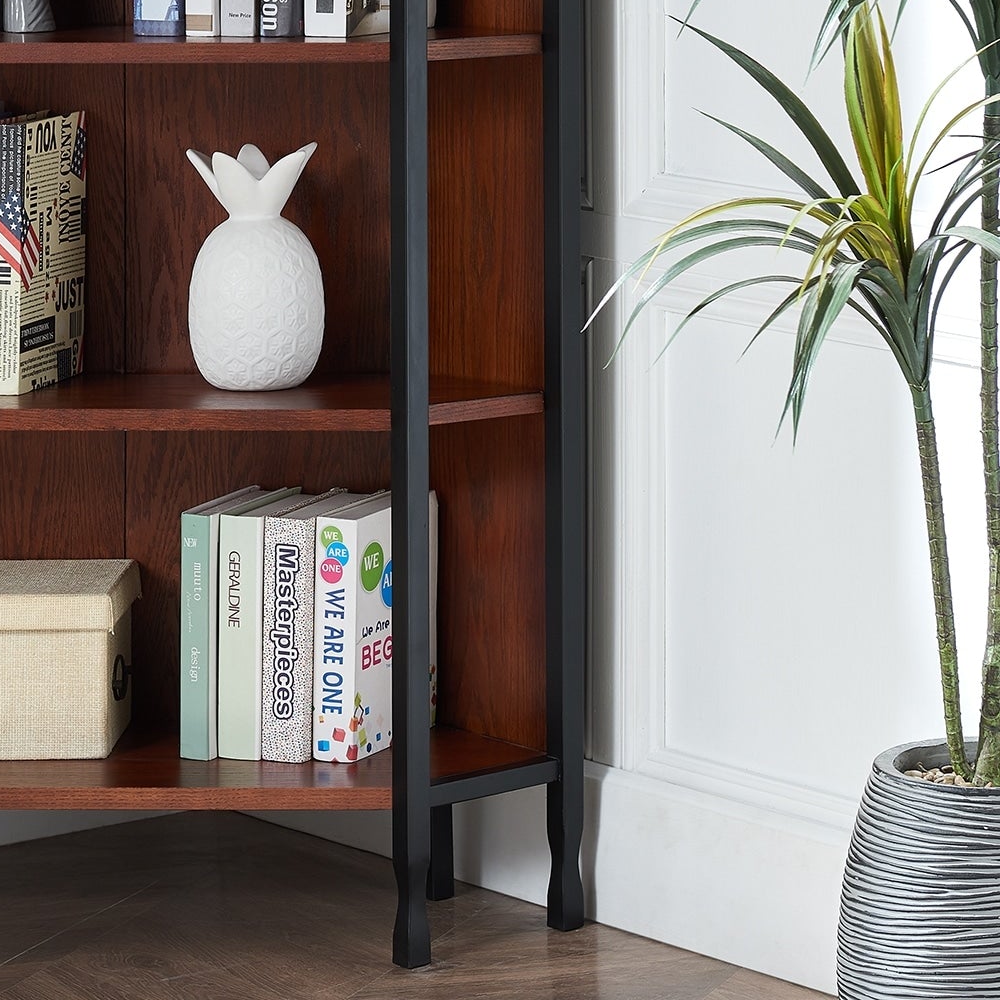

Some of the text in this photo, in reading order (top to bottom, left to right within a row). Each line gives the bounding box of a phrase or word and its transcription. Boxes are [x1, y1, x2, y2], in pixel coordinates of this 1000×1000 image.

[35, 120, 57, 154] YOU
[55, 276, 84, 313] JUST
[323, 531, 339, 540] WE
[328, 548, 347, 557] ARE
[322, 564, 341, 573] ONE
[363, 553, 379, 572] WE
[193, 562, 202, 601] muuto
[228, 551, 241, 628] GERALDINE
[270, 544, 300, 719] Masterpieces
[361, 619, 390, 639] We Are
[190, 646, 201, 682] design
[321, 588, 345, 715] WE ARE ONE
